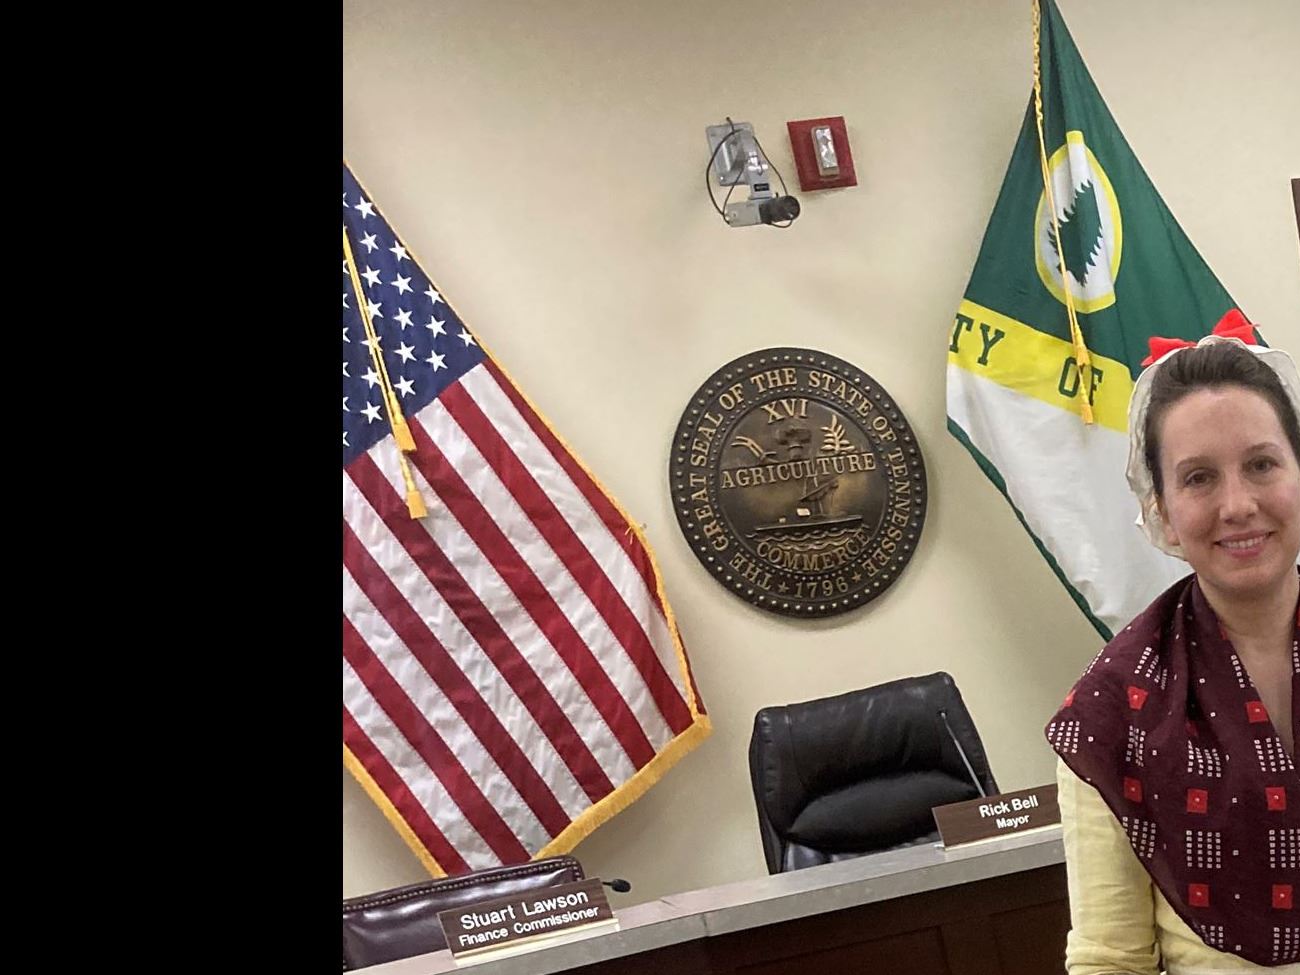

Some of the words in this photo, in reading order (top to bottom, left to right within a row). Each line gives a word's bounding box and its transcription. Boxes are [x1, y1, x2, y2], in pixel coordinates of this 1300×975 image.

[718, 384, 745, 411] OF
[750, 367, 798, 393] THE
[808, 370, 874, 417] STATE
[761, 399, 810, 424] XVI
[872, 416, 897, 443] OF
[690, 412, 724, 467] SEAL
[721, 452, 876, 489] AGRICULTURE
[690, 474, 729, 551] GREAT
[861, 447, 911, 577] TENNESSEE
[756, 528, 870, 572] COMMERCE
[729, 552, 772, 591] THE
[794, 576, 849, 598] 1796
[979, 801, 1010, 818] Rick
[1011, 795, 1038, 811] Bell
[996, 814, 1030, 829] Mayor
[458, 927, 508, 946] Finance
[513, 907, 599, 934] Commissioner
[460, 906, 516, 930] Stuart
[521, 891, 588, 916] Lawson
